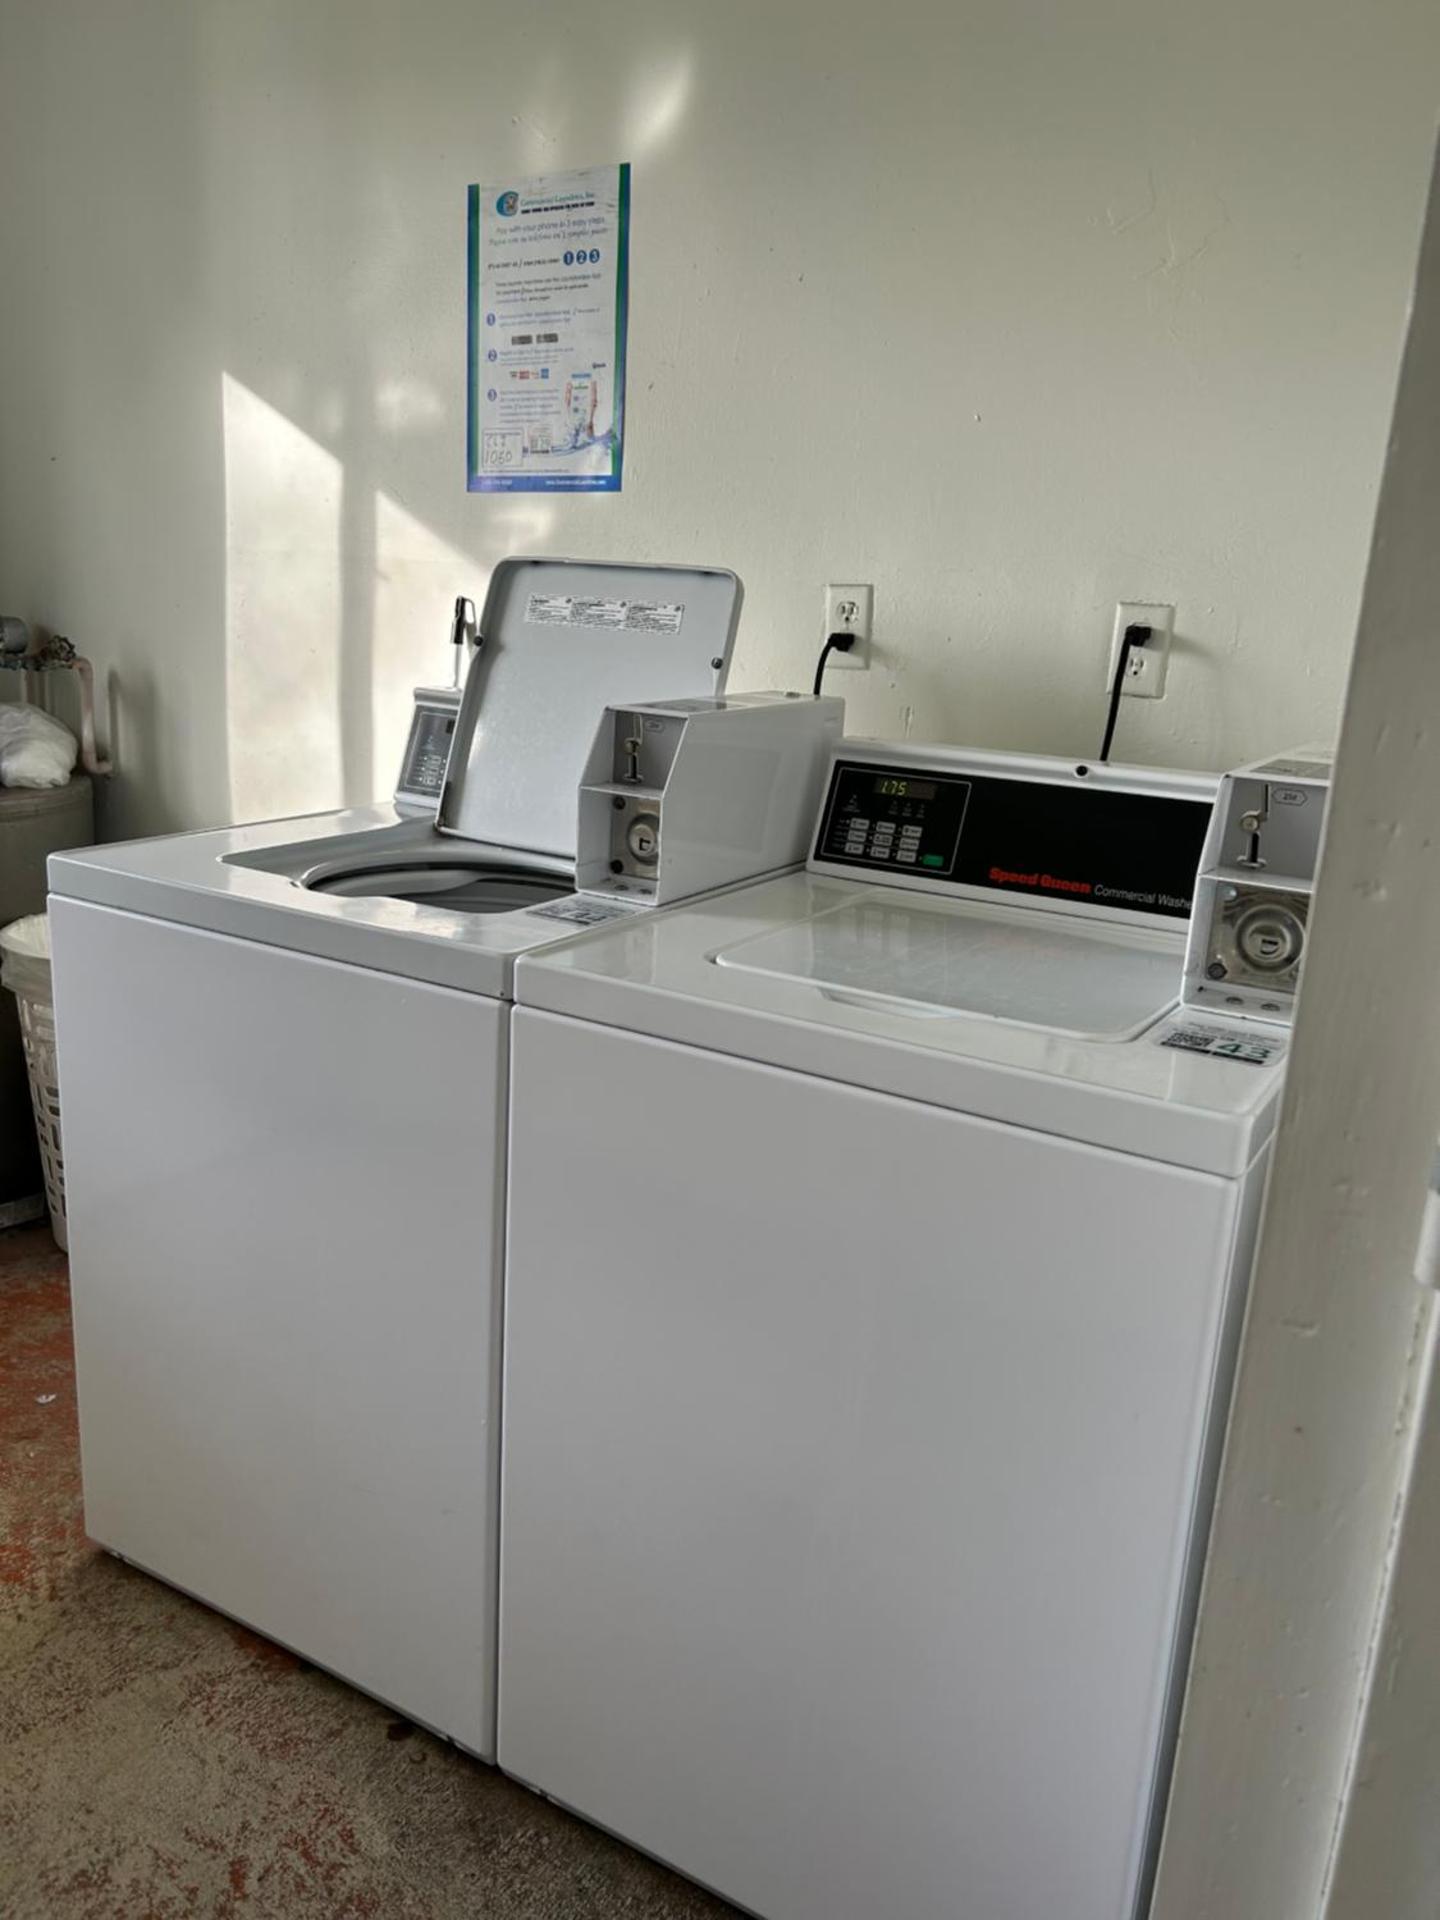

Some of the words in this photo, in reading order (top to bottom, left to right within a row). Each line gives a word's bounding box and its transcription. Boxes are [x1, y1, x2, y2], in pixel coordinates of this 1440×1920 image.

[989, 867, 1039, 885] Speed
[1040, 874, 1092, 894] Queen
[1094, 884, 1156, 904] Commercial
[1157, 893, 1192, 910] Washe
